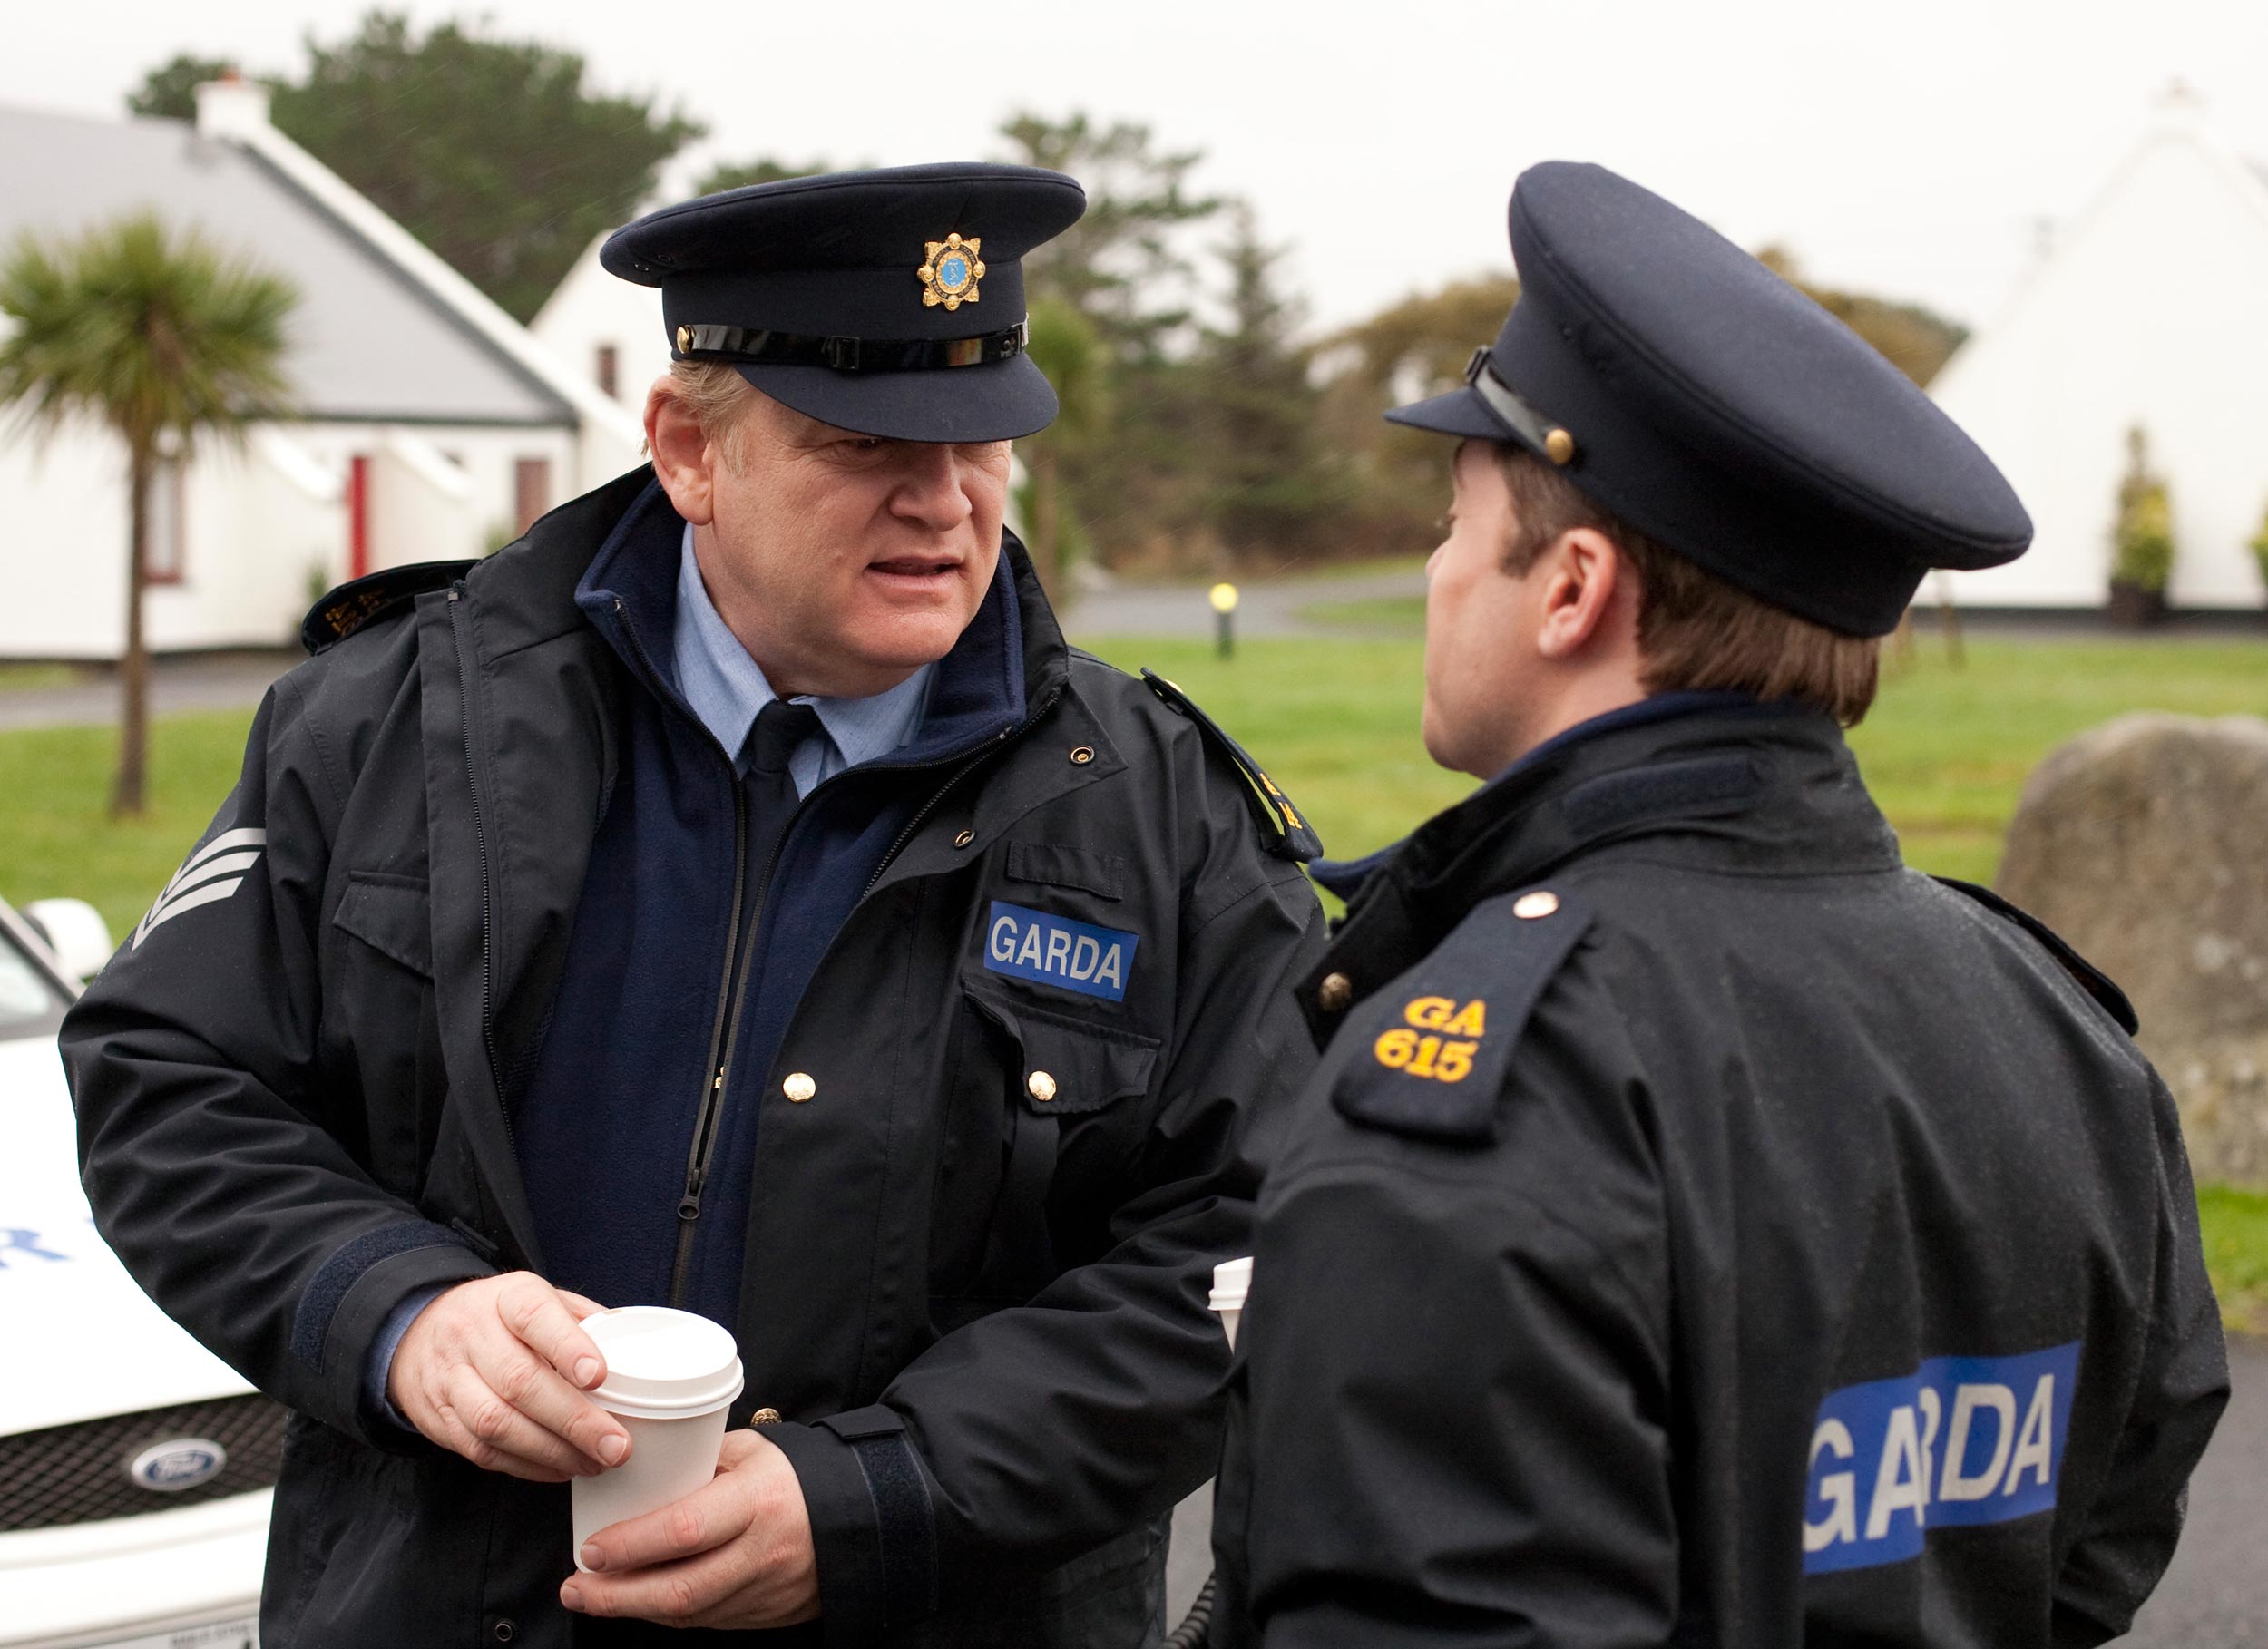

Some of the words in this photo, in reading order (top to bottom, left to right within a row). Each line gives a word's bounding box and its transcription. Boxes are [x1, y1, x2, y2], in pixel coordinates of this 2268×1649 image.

[991, 916, 1121, 989] GARDA
[1404, 996, 1486, 1038] GA
[1374, 1028, 1480, 1083] 615
